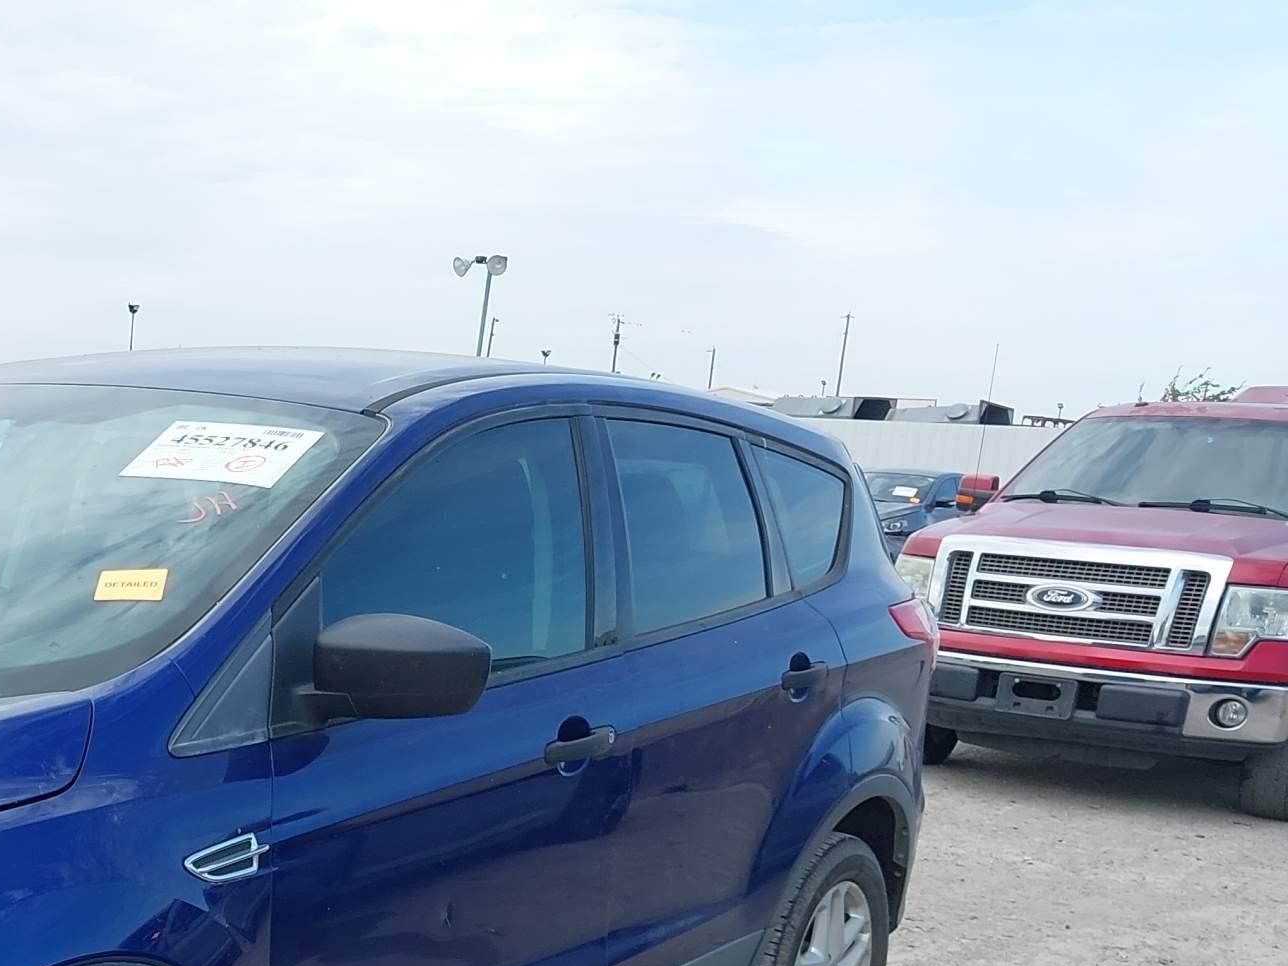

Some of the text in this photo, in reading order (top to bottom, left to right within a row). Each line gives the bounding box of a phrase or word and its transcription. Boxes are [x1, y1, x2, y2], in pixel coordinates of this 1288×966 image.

[170, 433, 289, 452] 45527846
[104, 581, 159, 589] DETAILED
[1042, 589, 1075, 604] Ford
